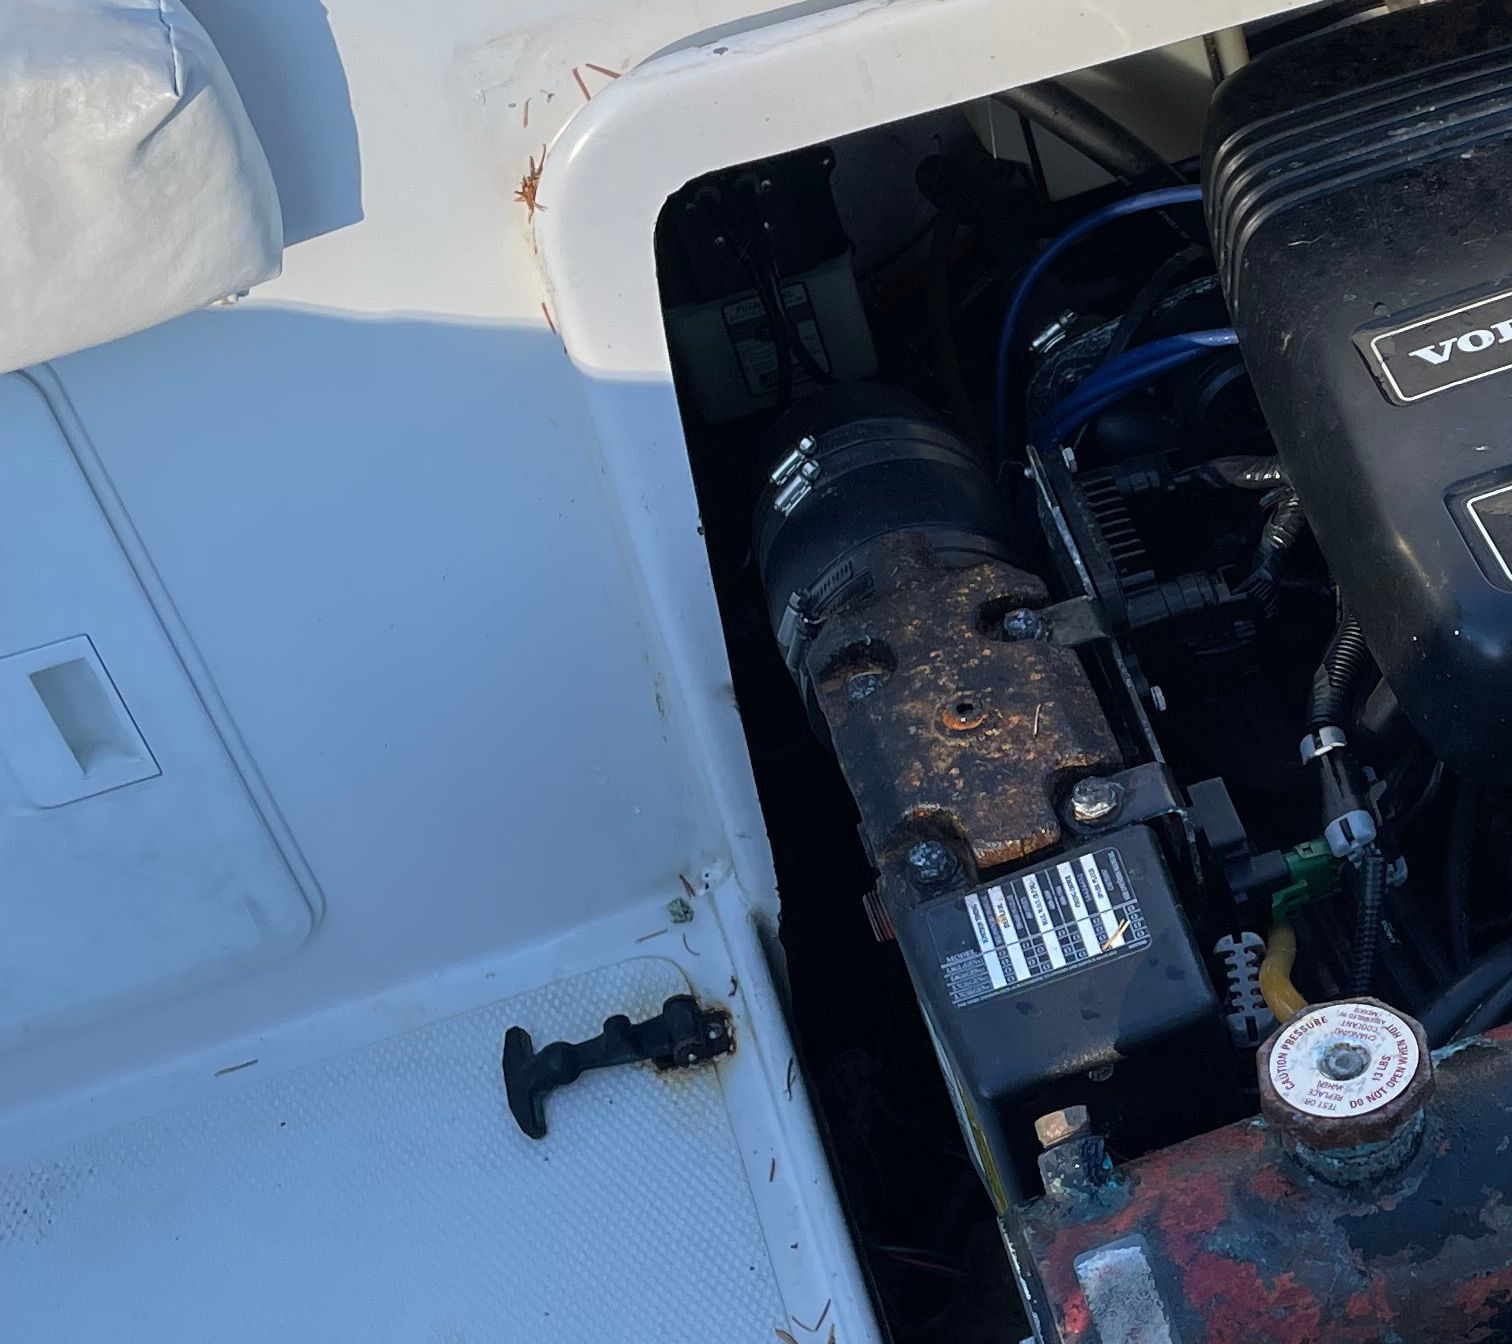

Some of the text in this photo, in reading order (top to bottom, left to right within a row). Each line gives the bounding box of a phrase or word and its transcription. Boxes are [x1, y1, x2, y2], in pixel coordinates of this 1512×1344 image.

[1340, 1020, 1378, 1033] COOLANT
[1333, 1027, 1376, 1042] CHANGING
[1276, 1015, 1328, 1091] CAUTION PRESSURE
[1349, 1023, 1408, 1109] DO NOT OPEN WHEN HOT
[1371, 1054, 1391, 1082] 13 LBS
[1307, 1088, 1343, 1102] REPLACE
[1304, 1097, 1336, 1111] TEST OR
